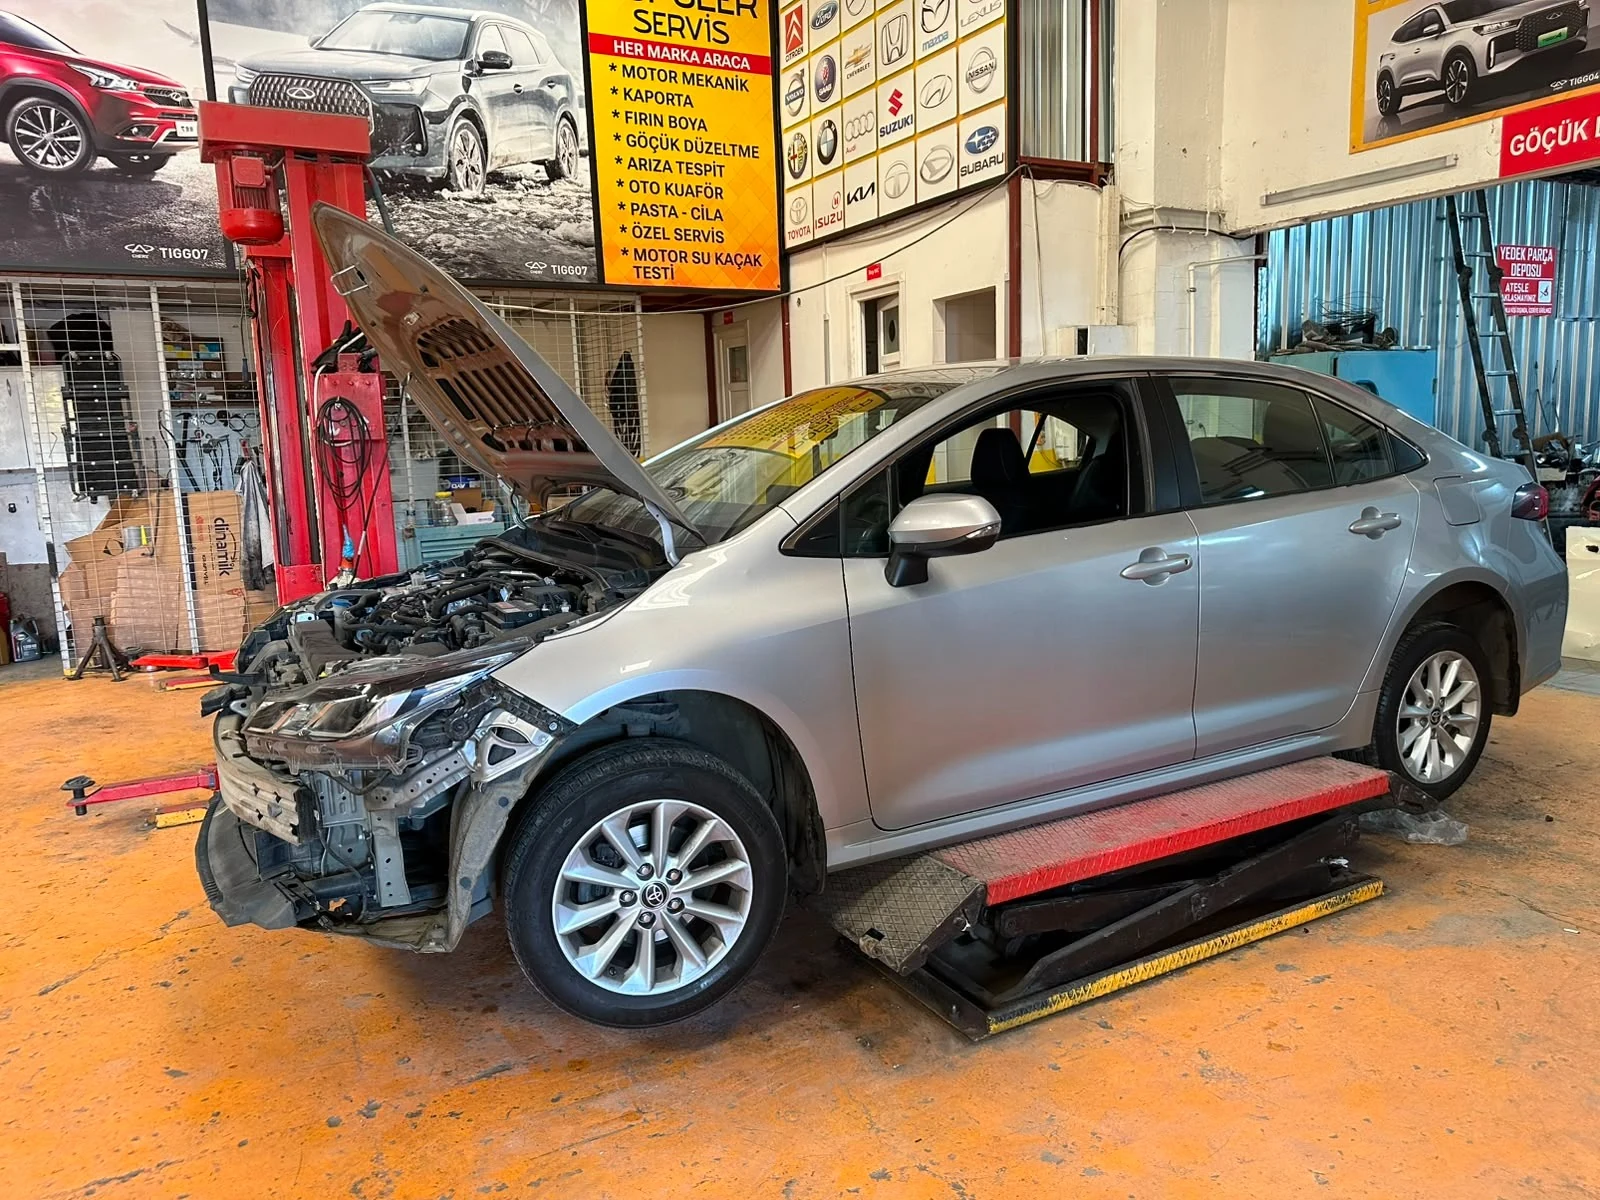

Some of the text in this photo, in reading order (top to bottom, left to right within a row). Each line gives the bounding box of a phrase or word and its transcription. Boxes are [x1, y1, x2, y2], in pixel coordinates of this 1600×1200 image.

[960, 2, 1002, 27] LEXUS
[633, 9, 730, 45] SERVİS
[613, 40, 751, 70] HER MARKA ARACA
[622, 65, 750, 92] MOTOR MEKANİK
[847, 62, 871, 80] CHEVROLET
[968, 62, 994, 78] NISSAN
[623, 88, 694, 108] KAPORTA
[625, 111, 708, 132] FIRIN BOYA
[879, 114, 913, 138] SUZUKI
[626, 131, 760, 159] GÖÇÜK DÜZELTME
[1509, 117, 1591, 156] GÖÇÜK
[627, 157, 725, 178] ARIZA TESPİT
[960, 152, 1004, 177] SUBARU
[629, 180, 724, 200] OTO KUAFÖR
[630, 203, 679, 219] PASTA
[690, 204, 724, 222] CİLA
[815, 211, 843, 230] ISUZU
[632, 222, 725, 244] ÖZEL SERVİS
[788, 225, 811, 240] TOYOTA
[159, 247, 209, 260] TIGGO7
[634, 248, 763, 270] MOTOR SU KAÇAK
[1500, 246, 1554, 264] YEDEK PARÇA
[550, 265, 588, 276] TIGGO7
[633, 264, 675, 280] TESTİ
[1511, 263, 1542, 278] DEPOSU
[1505, 283, 1530, 293] ATEŞLE
[213, 517, 233, 577] dinamik
